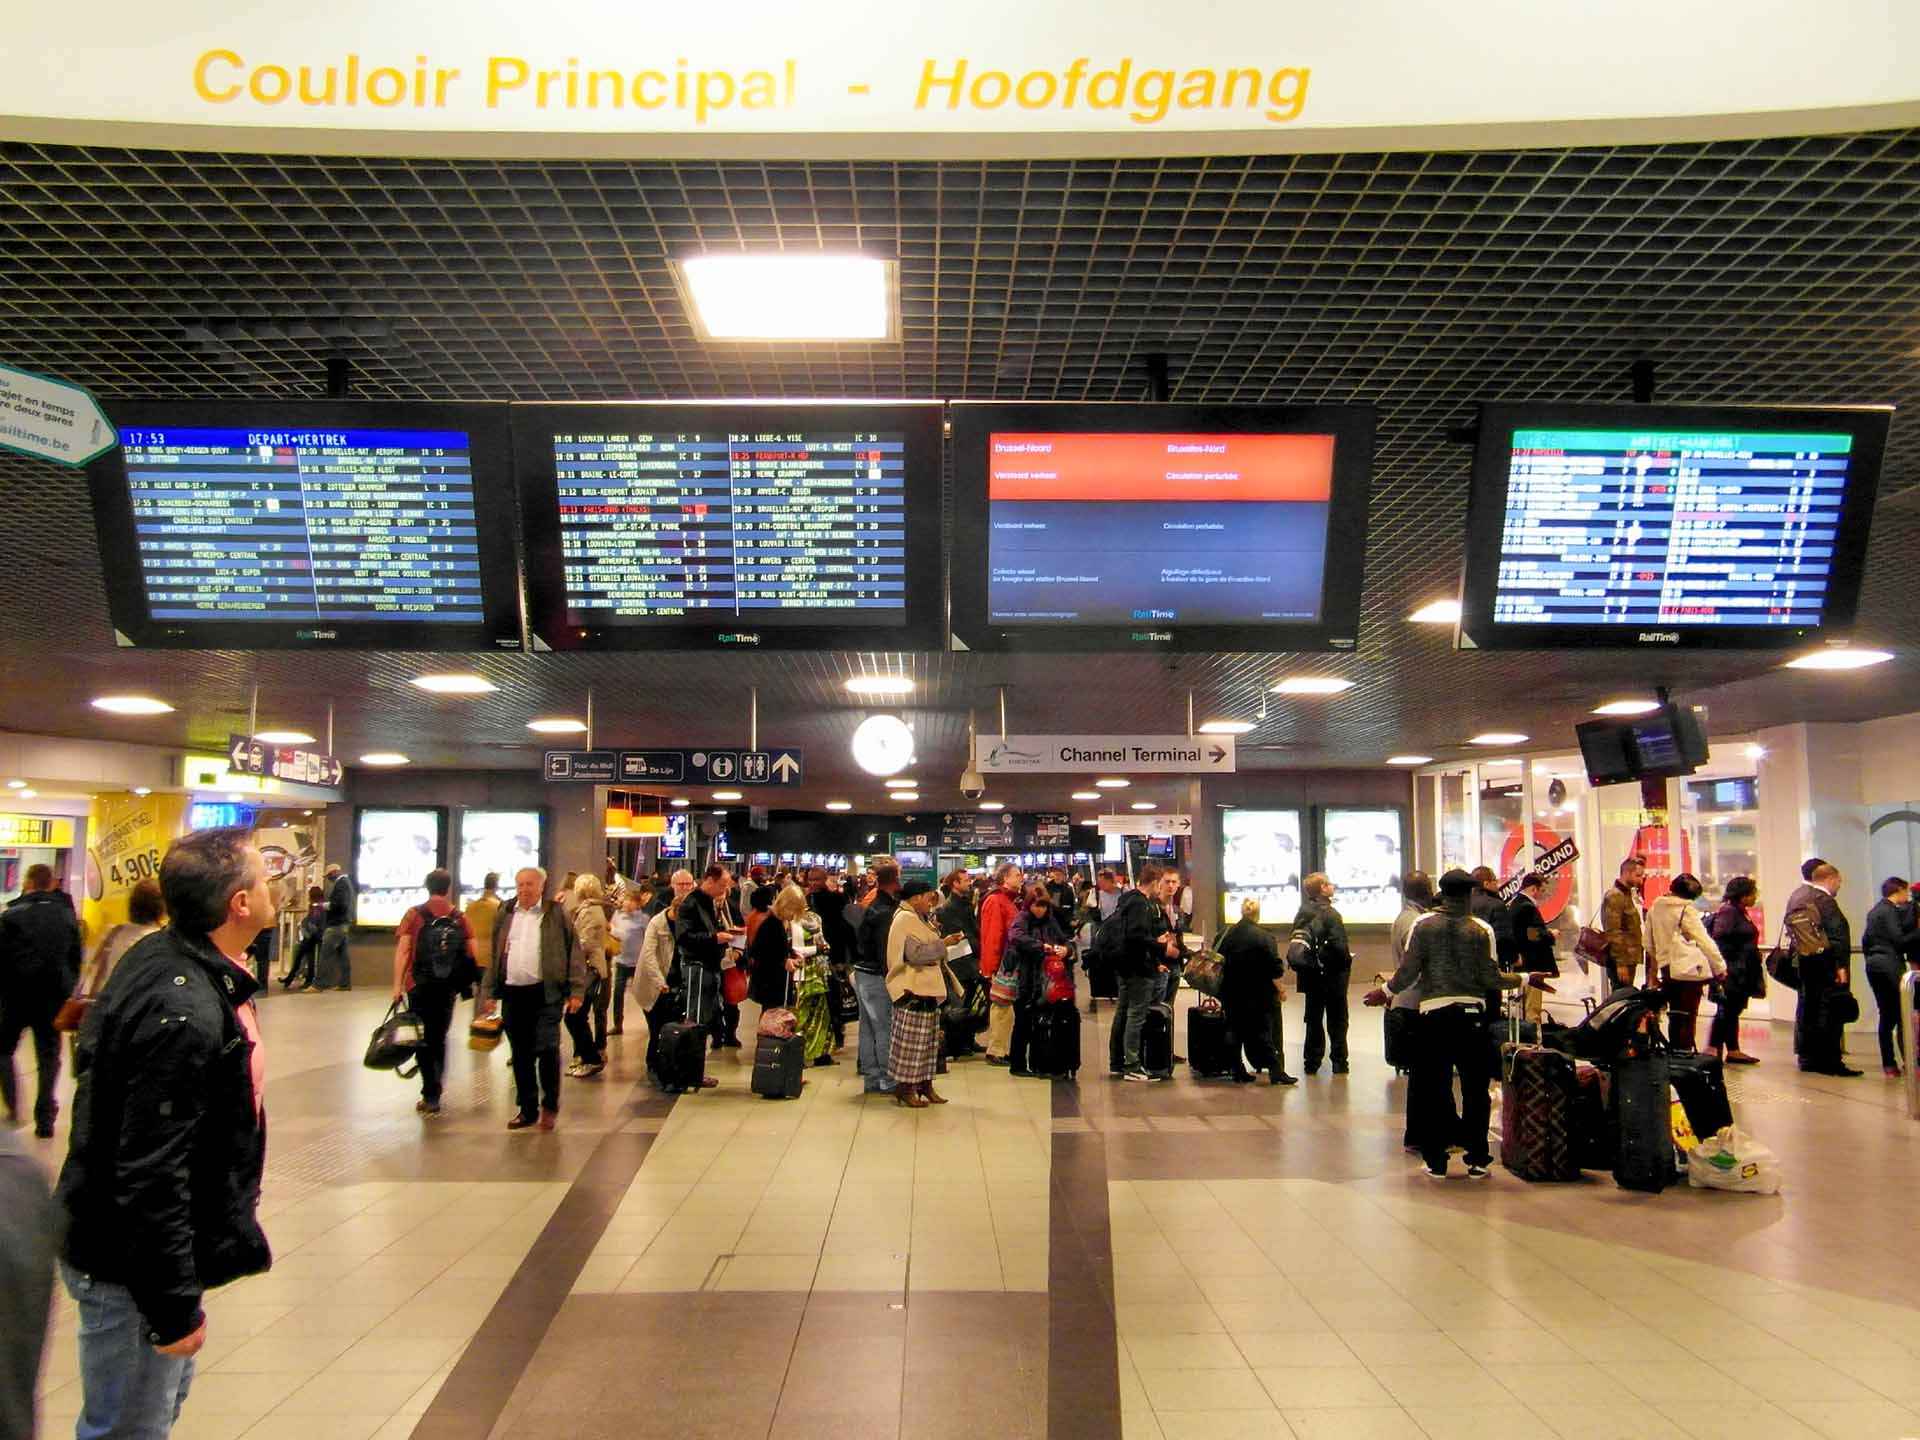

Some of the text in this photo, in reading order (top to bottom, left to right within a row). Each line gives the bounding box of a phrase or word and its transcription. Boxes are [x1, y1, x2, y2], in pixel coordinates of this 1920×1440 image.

[193, 48, 460, 107] Couloir
[486, 56, 797, 123] Principal
[914, 57, 1311, 122] Hoofdgang
[14, 404, 41, 416] deux
[44, 412, 73, 427] gares
[42, 400, 75, 416] temps
[130, 433, 164, 444] 17:53
[1060, 747, 1201, 762] Channel Terminal
